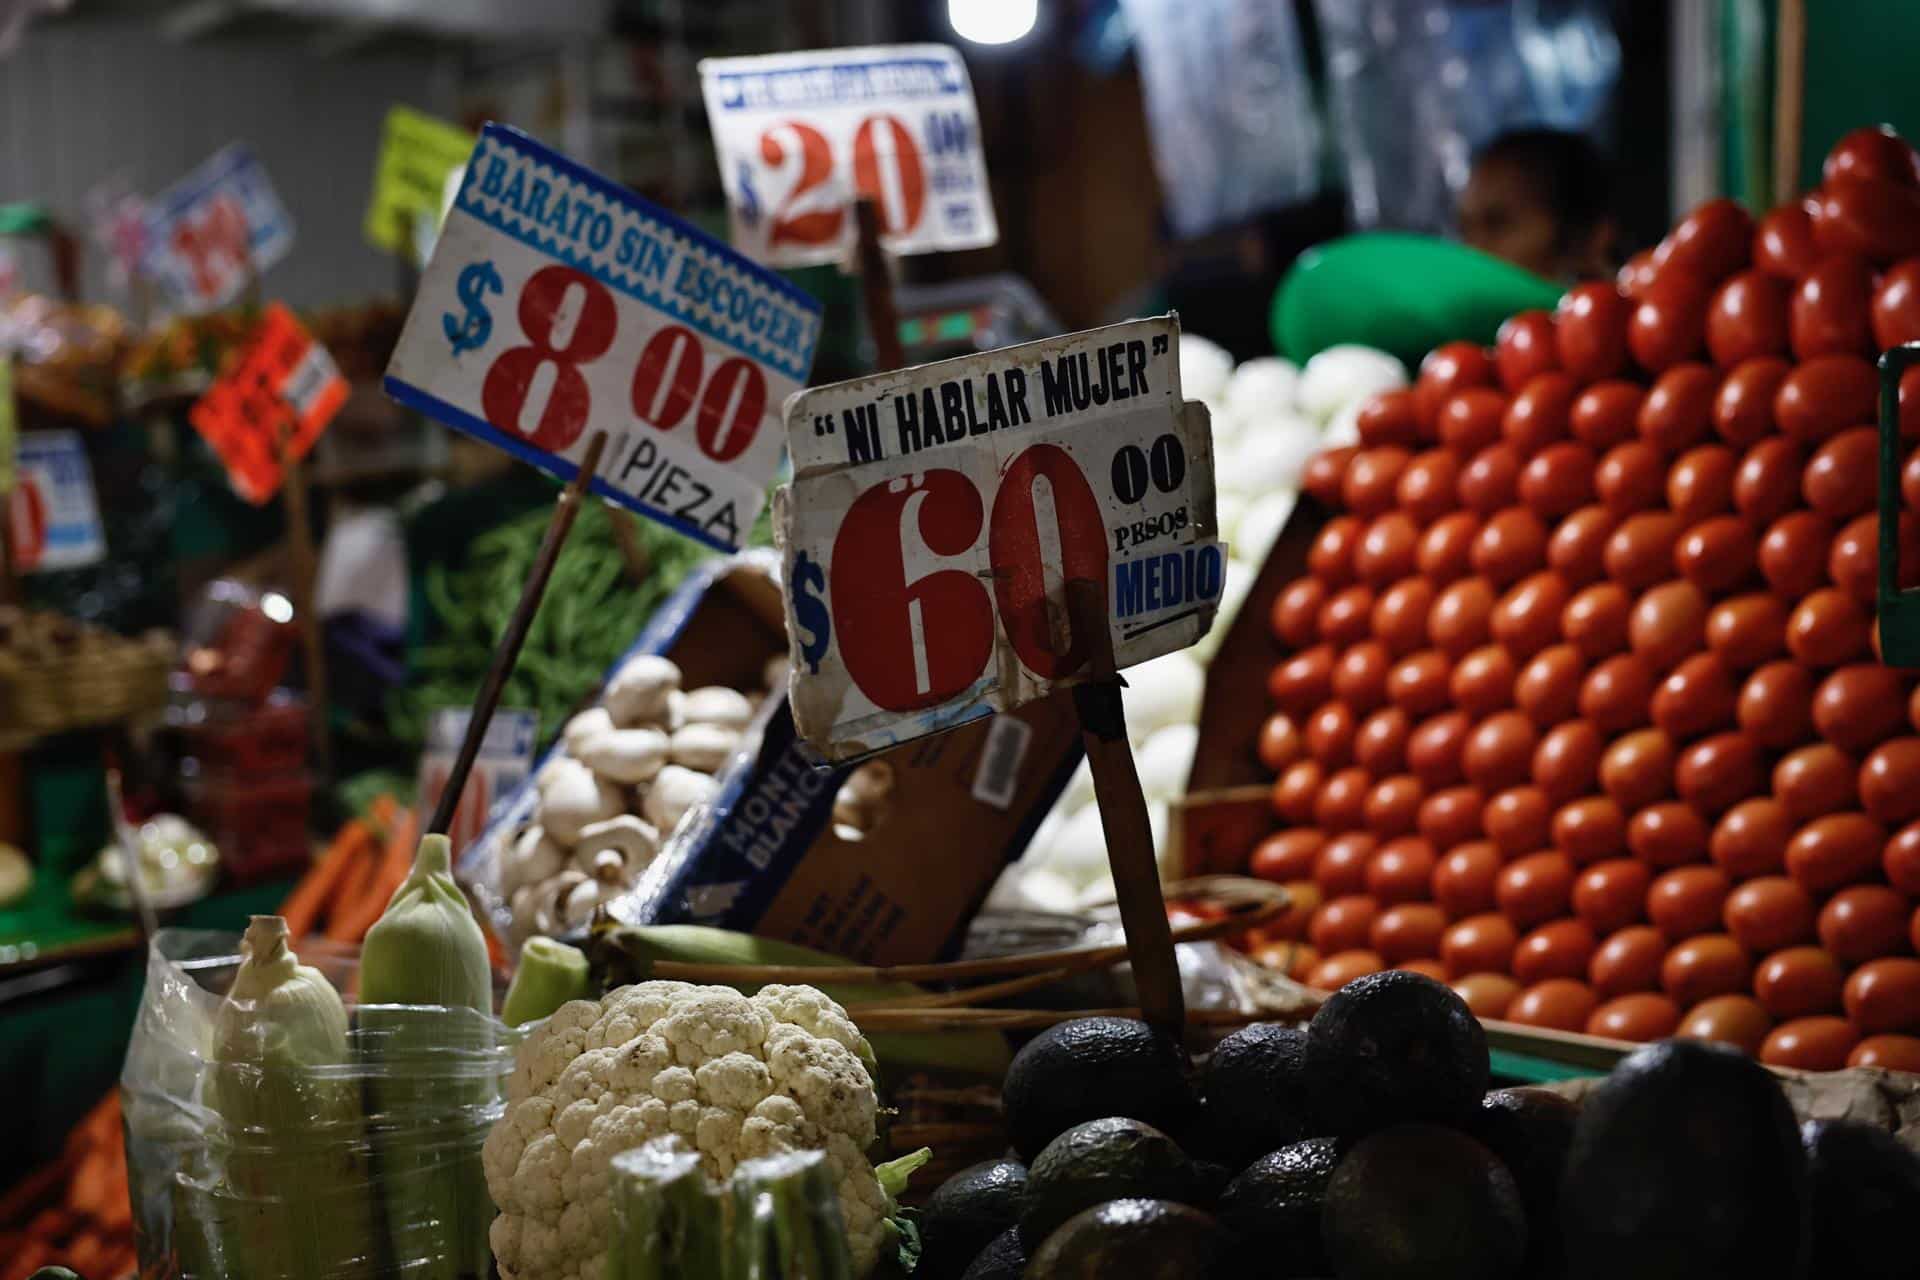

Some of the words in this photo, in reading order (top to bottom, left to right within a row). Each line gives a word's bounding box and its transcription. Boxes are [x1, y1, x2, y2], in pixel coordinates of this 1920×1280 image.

[760, 111, 927, 248] 20
[480, 153, 614, 252] BARATO
[616, 226, 676, 283] SIN
[674, 257, 803, 352] ESCOGER
[442, 260, 505, 358] $
[482, 264, 618, 452] 8
[630, 325, 768, 464] 00
[894, 367, 1032, 455] HABLAR
[621, 437, 739, 549] PIEZA
[1111, 433, 1186, 505] 00
[829, 442, 1110, 714] 60
[1114, 506, 1189, 553] PESOS
[1116, 545, 1222, 620] MEDIO
[745, 766, 832, 870] BLANC
